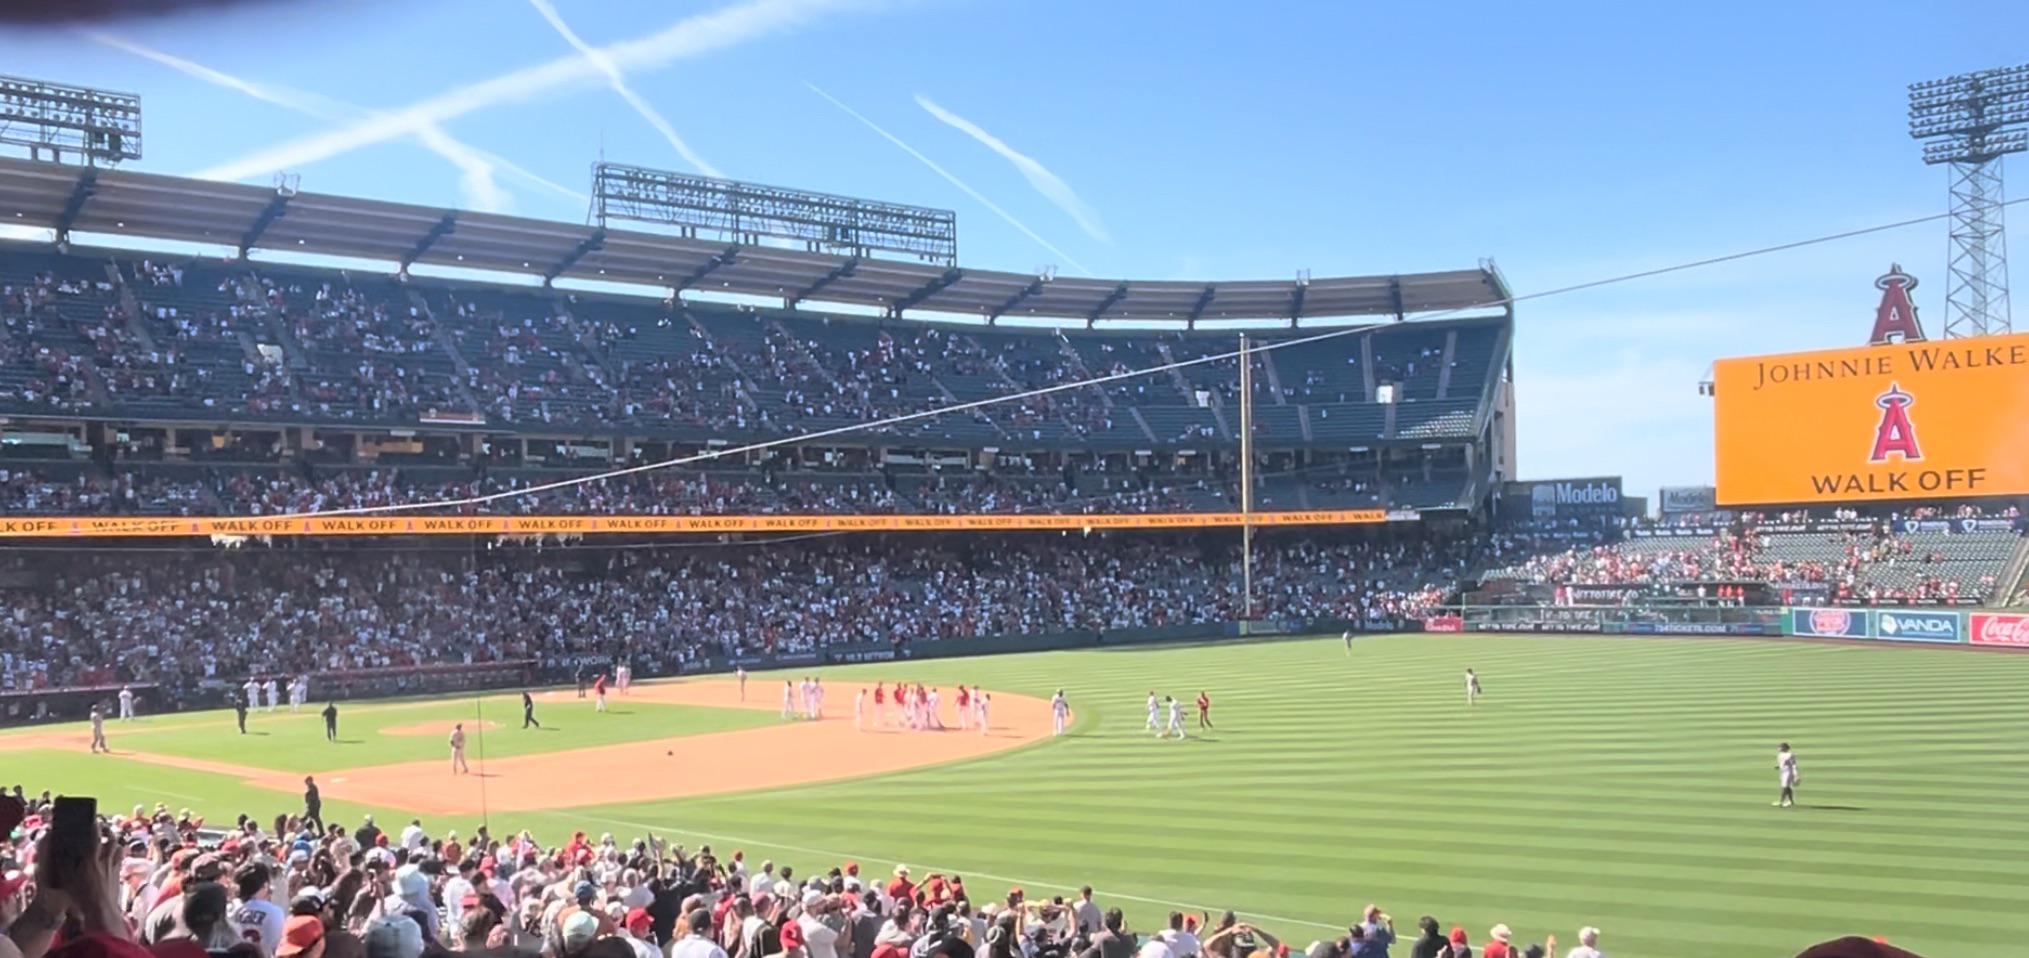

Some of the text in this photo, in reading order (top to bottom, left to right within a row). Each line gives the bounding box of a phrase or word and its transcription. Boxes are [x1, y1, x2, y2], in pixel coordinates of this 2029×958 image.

[1753, 345, 2027, 390] JOHNNIE WALKE
[1811, 468, 1986, 494] WALK OFF
[1556, 482, 1617, 505] Modelo
[211, 520, 293, 531] WALK OFF
[322, 520, 397, 530] WALK OFF
[425, 519, 493, 529] WALK OFF
[519, 519, 583, 529] WALK OFF
[607, 519, 668, 529] WALK OFF
[689, 519, 745, 529] WALK OFF
[1897, 618, 1954, 632] VANDA
